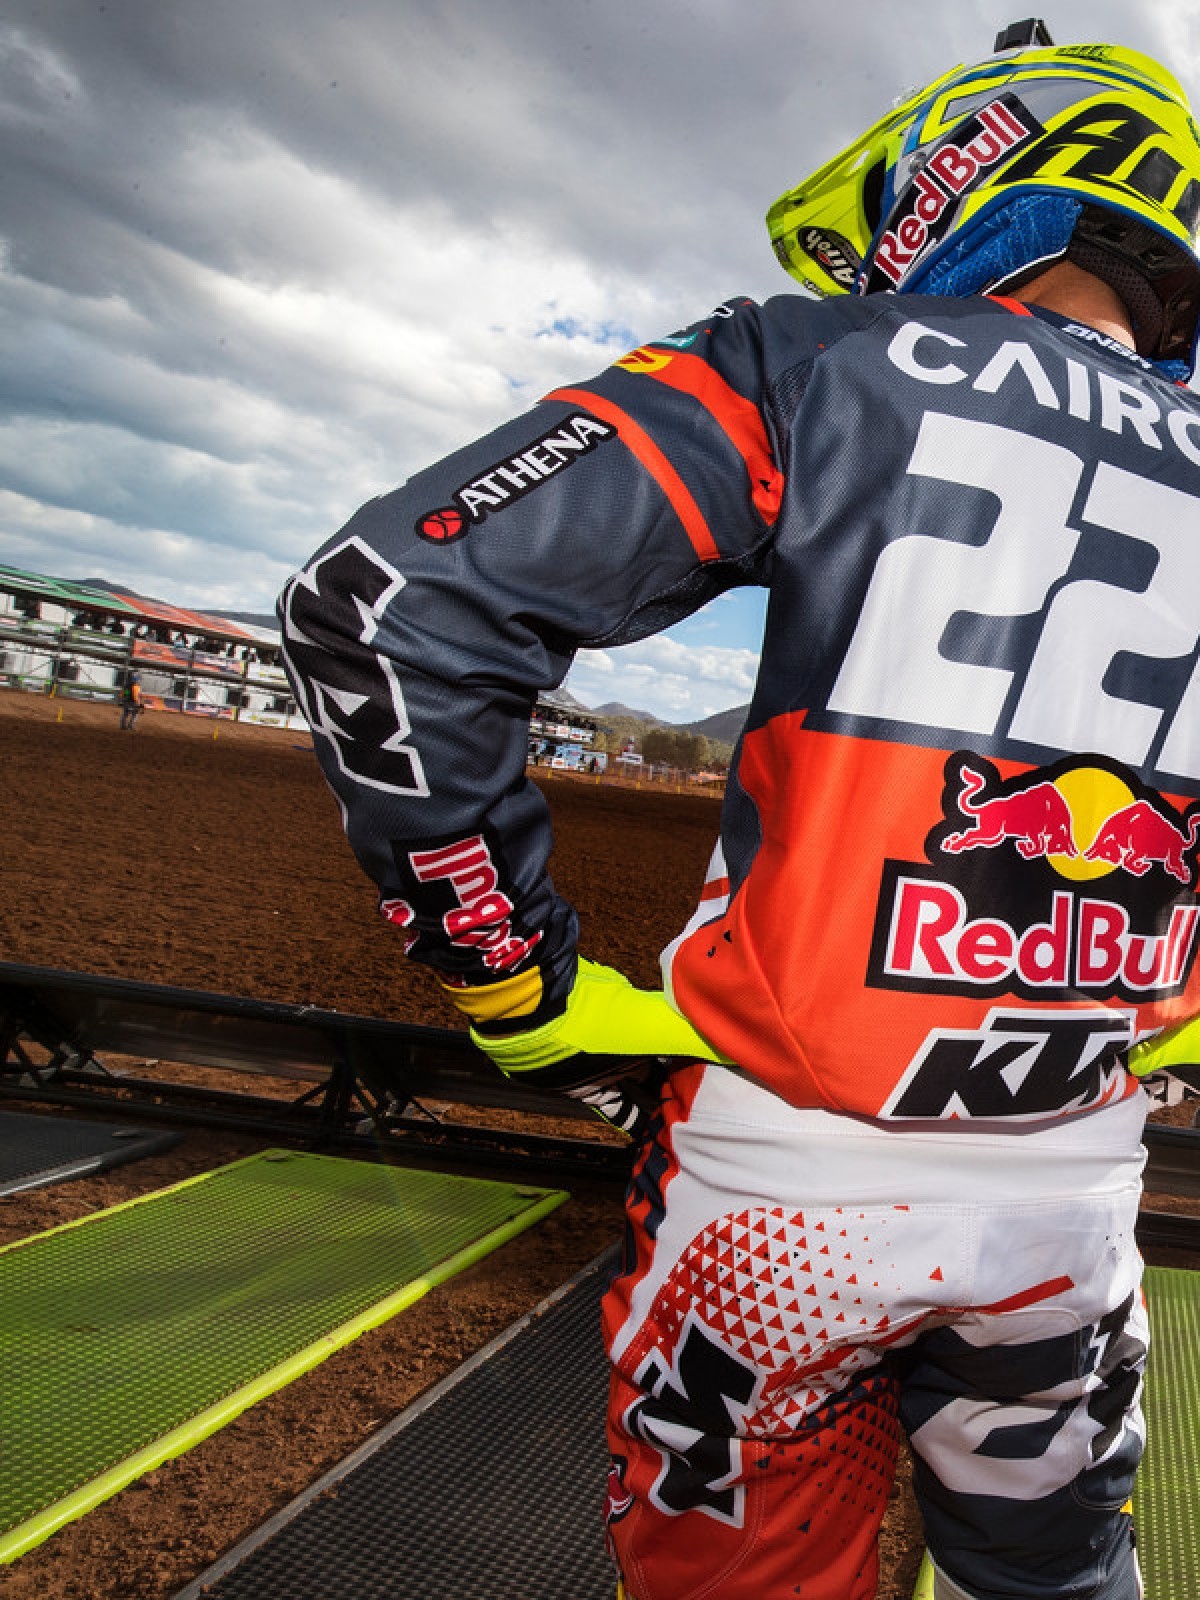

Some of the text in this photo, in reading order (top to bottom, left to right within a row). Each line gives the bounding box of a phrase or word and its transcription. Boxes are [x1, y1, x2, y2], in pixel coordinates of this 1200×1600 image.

[874, 102, 1030, 284] Red Bull
[459, 415, 610, 518] ATHENA
[883, 876, 1074, 986] Red
[877, 1006, 1165, 1122] KTM
